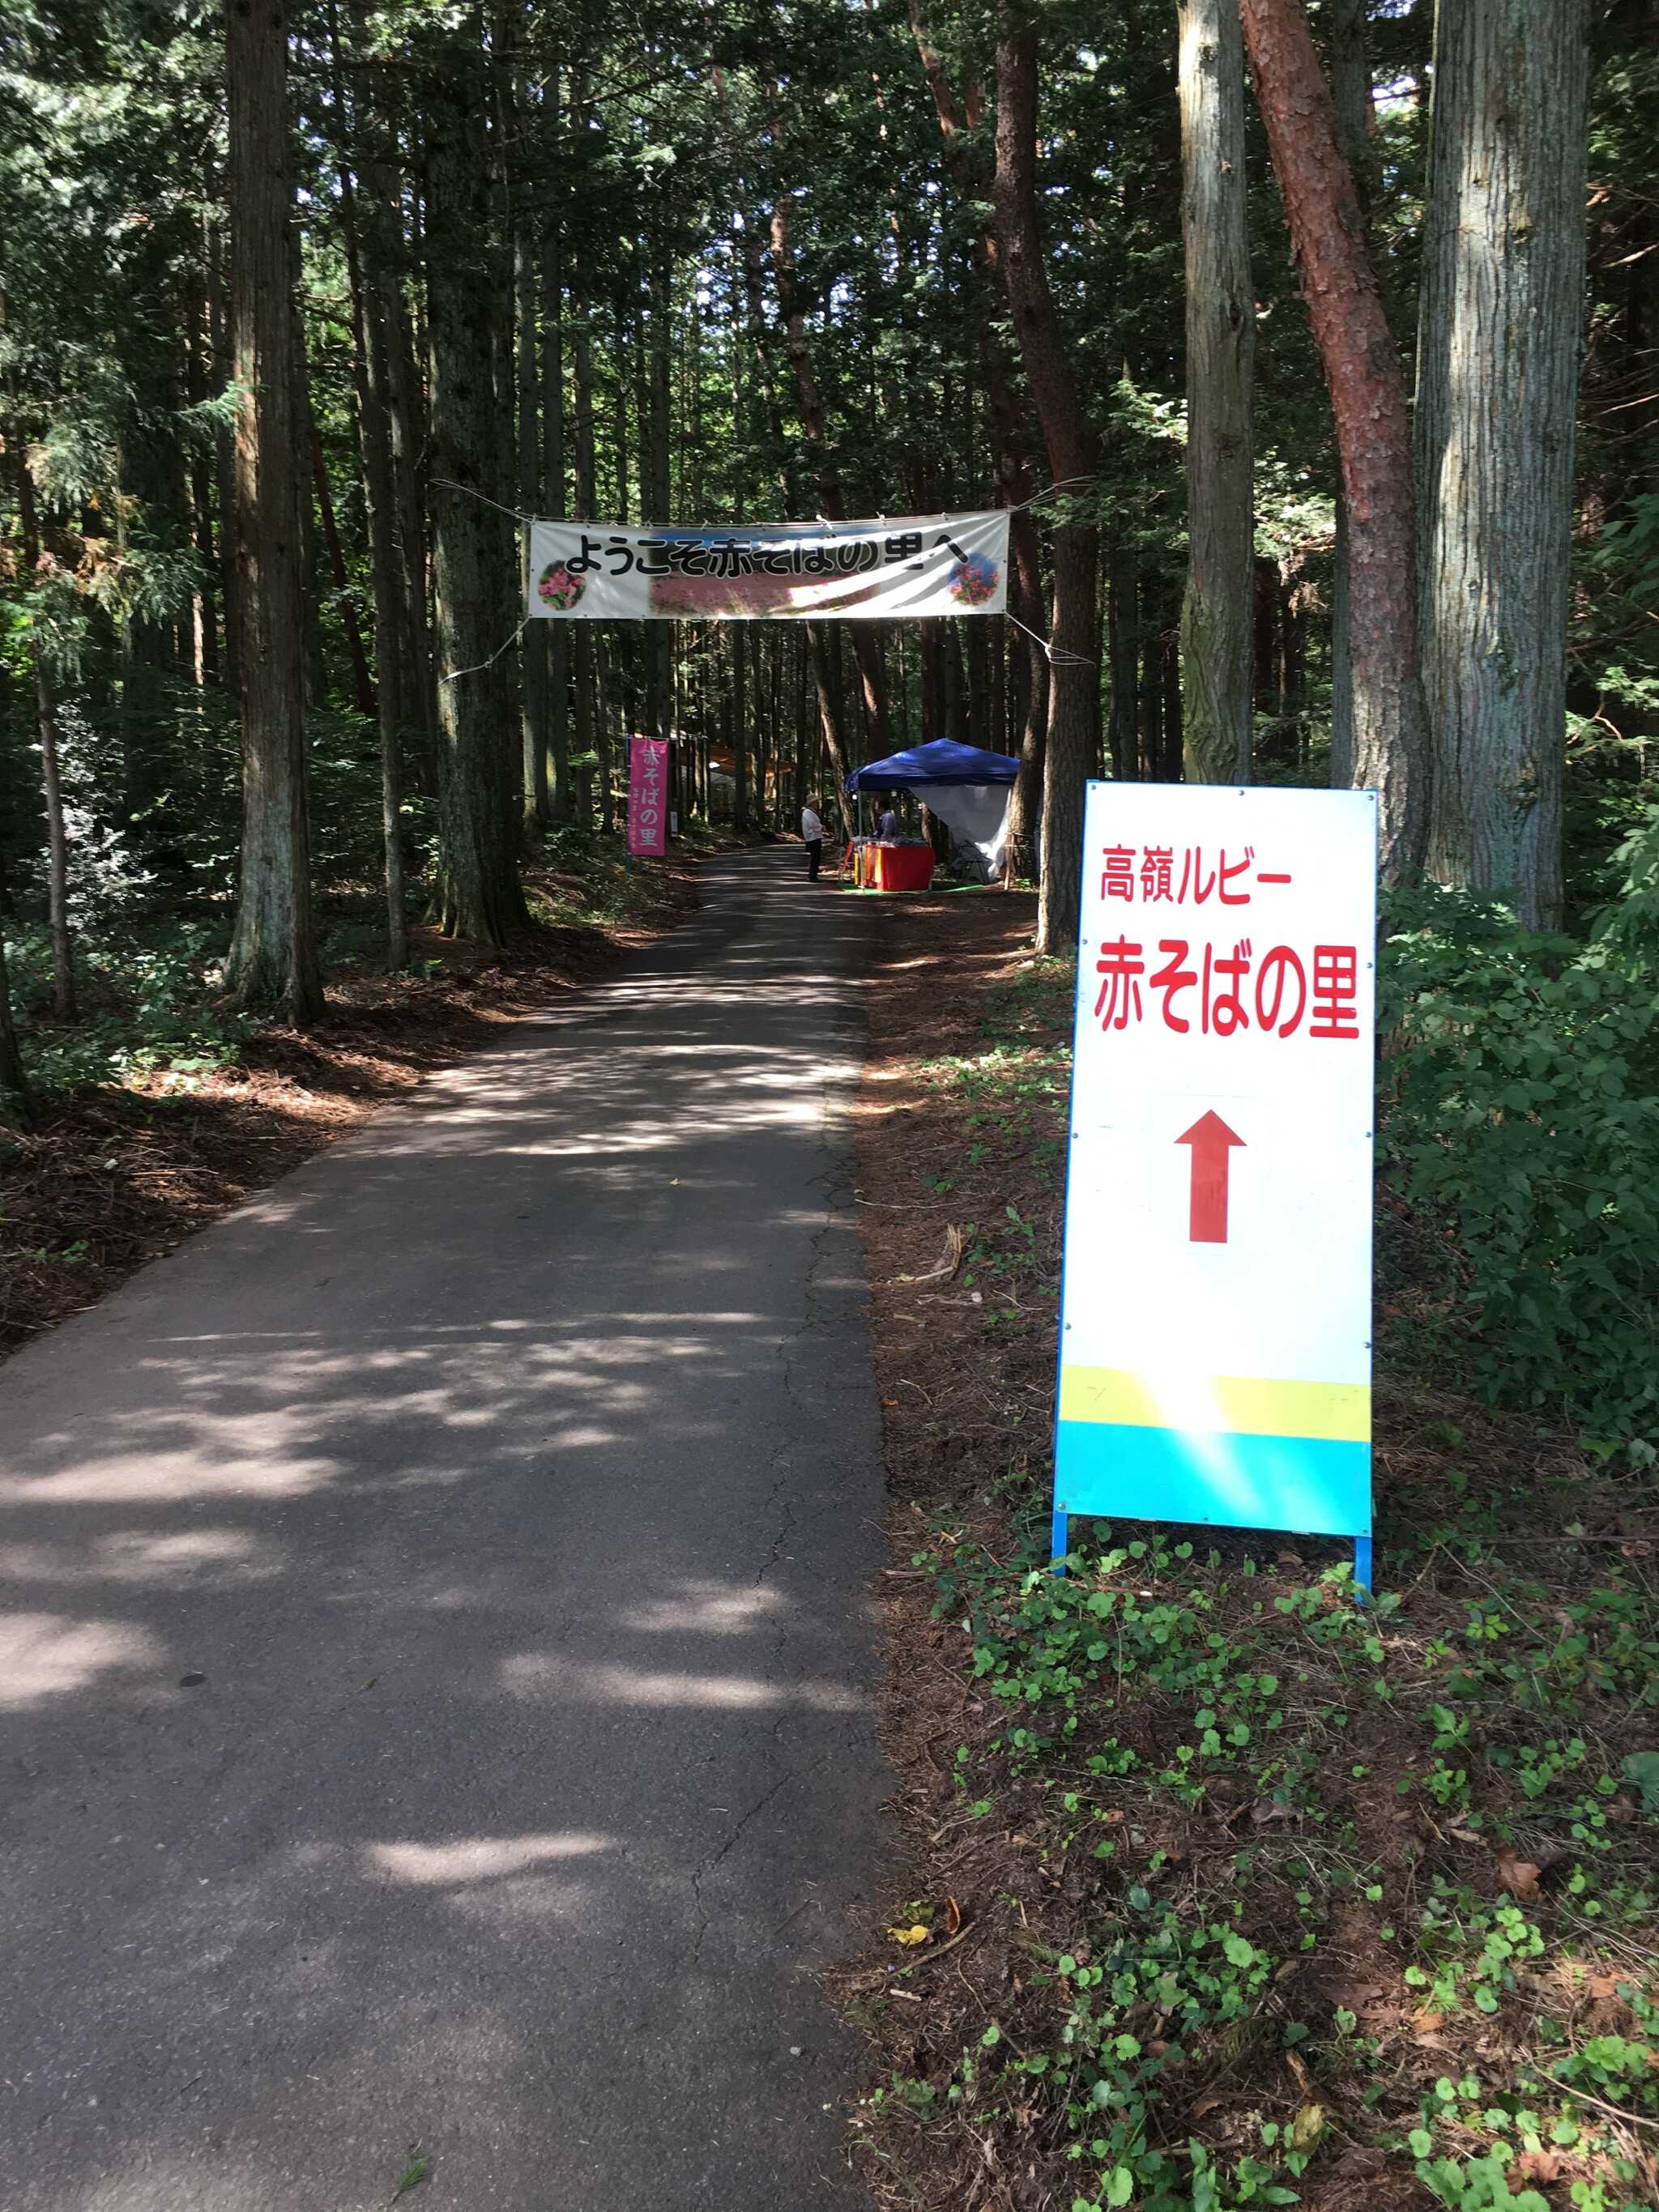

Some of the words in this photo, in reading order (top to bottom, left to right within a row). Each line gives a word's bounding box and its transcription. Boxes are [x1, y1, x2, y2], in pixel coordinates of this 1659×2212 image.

[566, 532, 969, 578] ようこそ赤そばの里へ
[639, 745, 661, 846] 赤そばの里
[1101, 844, 1291, 905] 高嶺ルビー
[1094, 934, 1359, 1038] 赤そばの里
